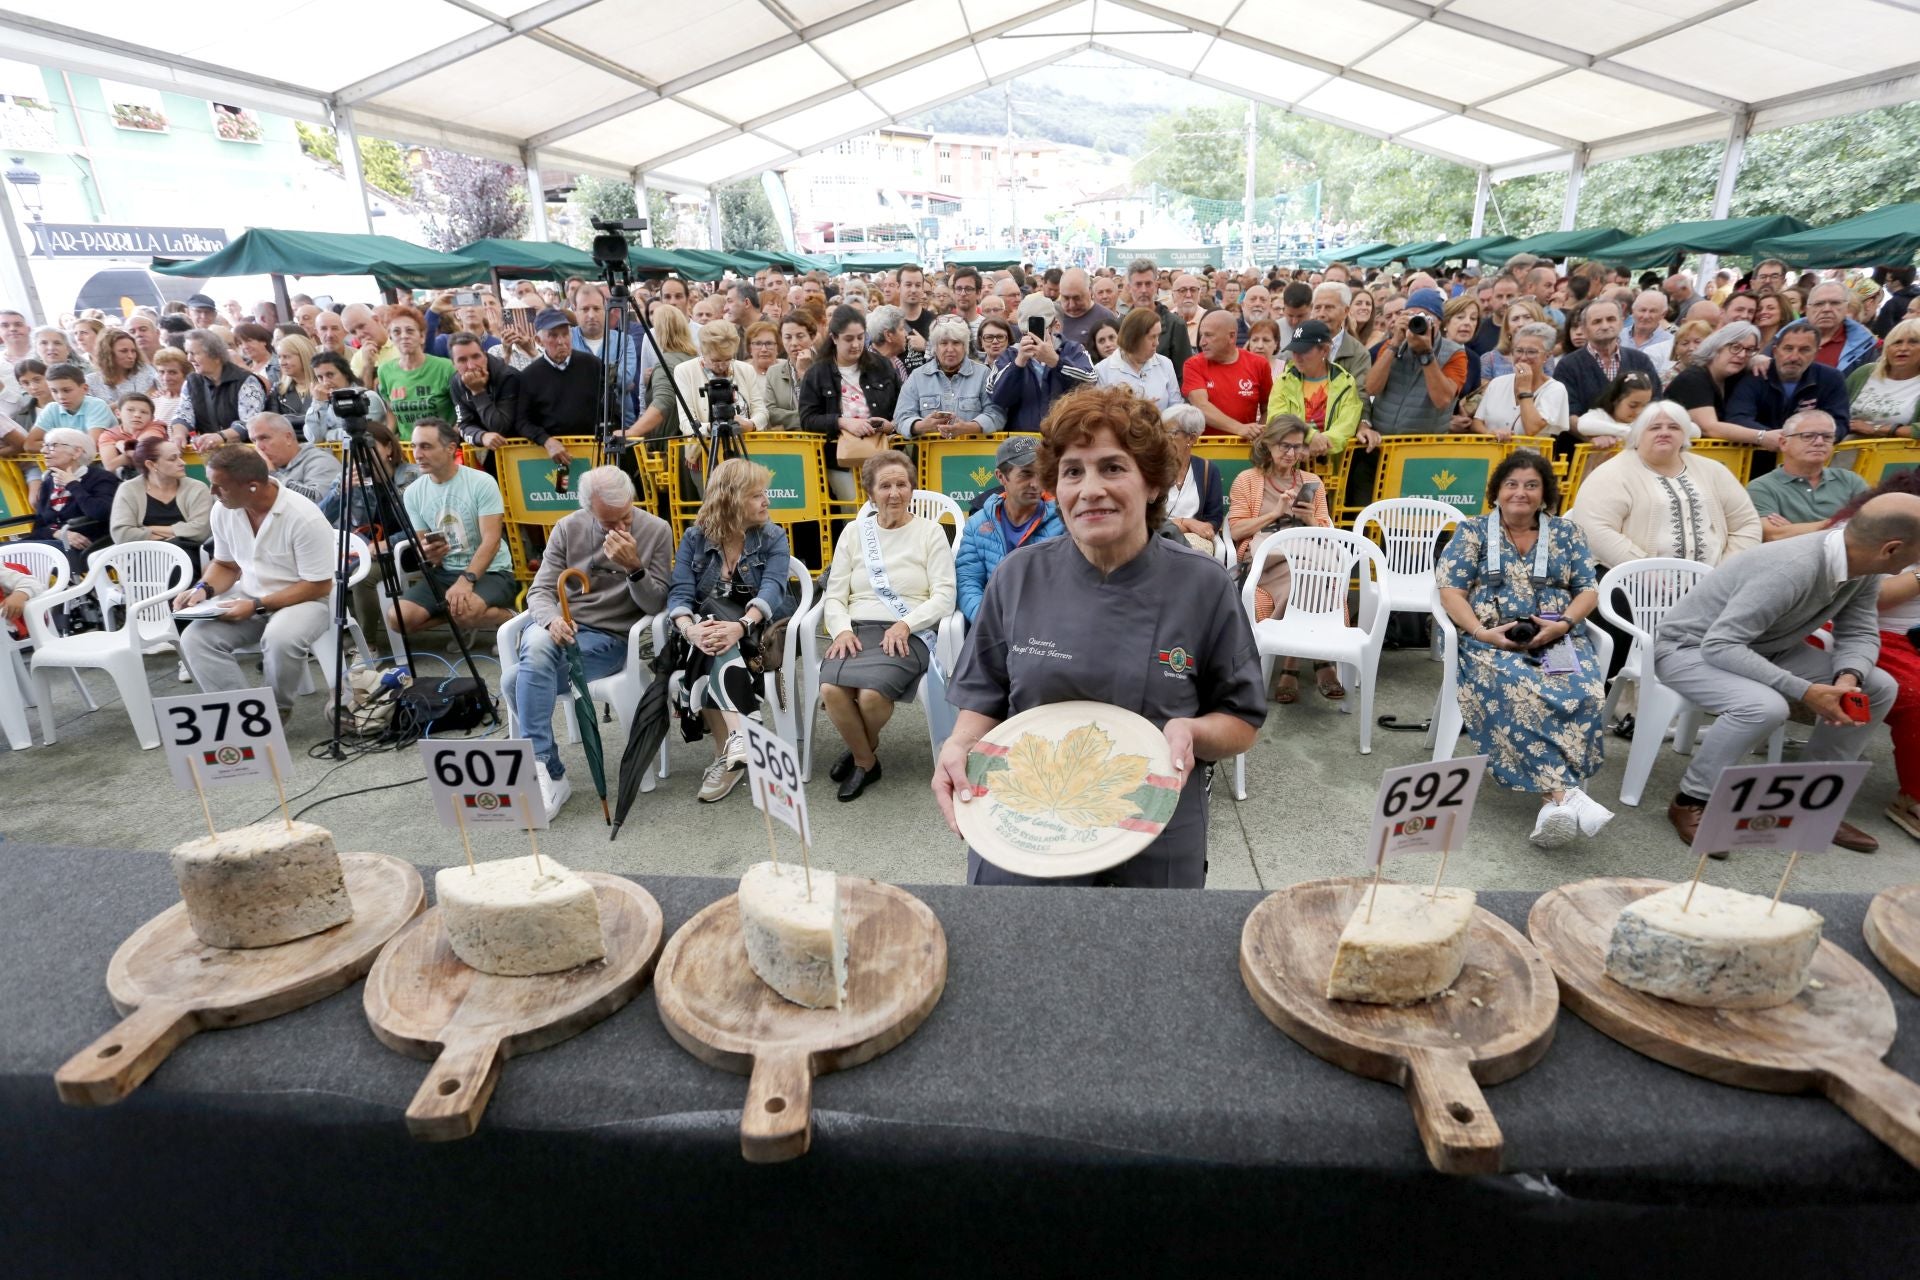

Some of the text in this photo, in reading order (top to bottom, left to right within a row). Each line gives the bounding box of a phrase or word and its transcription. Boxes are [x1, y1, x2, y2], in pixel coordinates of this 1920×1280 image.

[163, 233, 183, 252] La
[530, 491, 554, 501] CAJA
[950, 491, 975, 501] CAJA
[1438, 494, 1477, 505] RURAL
[863, 519, 880, 561] PASTORA
[871, 566, 898, 606] MAYOR
[168, 699, 272, 746] 378
[434, 749, 523, 787] 607
[748, 729, 798, 792] 569
[1383, 768, 1470, 817] 692
[1731, 774, 1844, 812] 150
